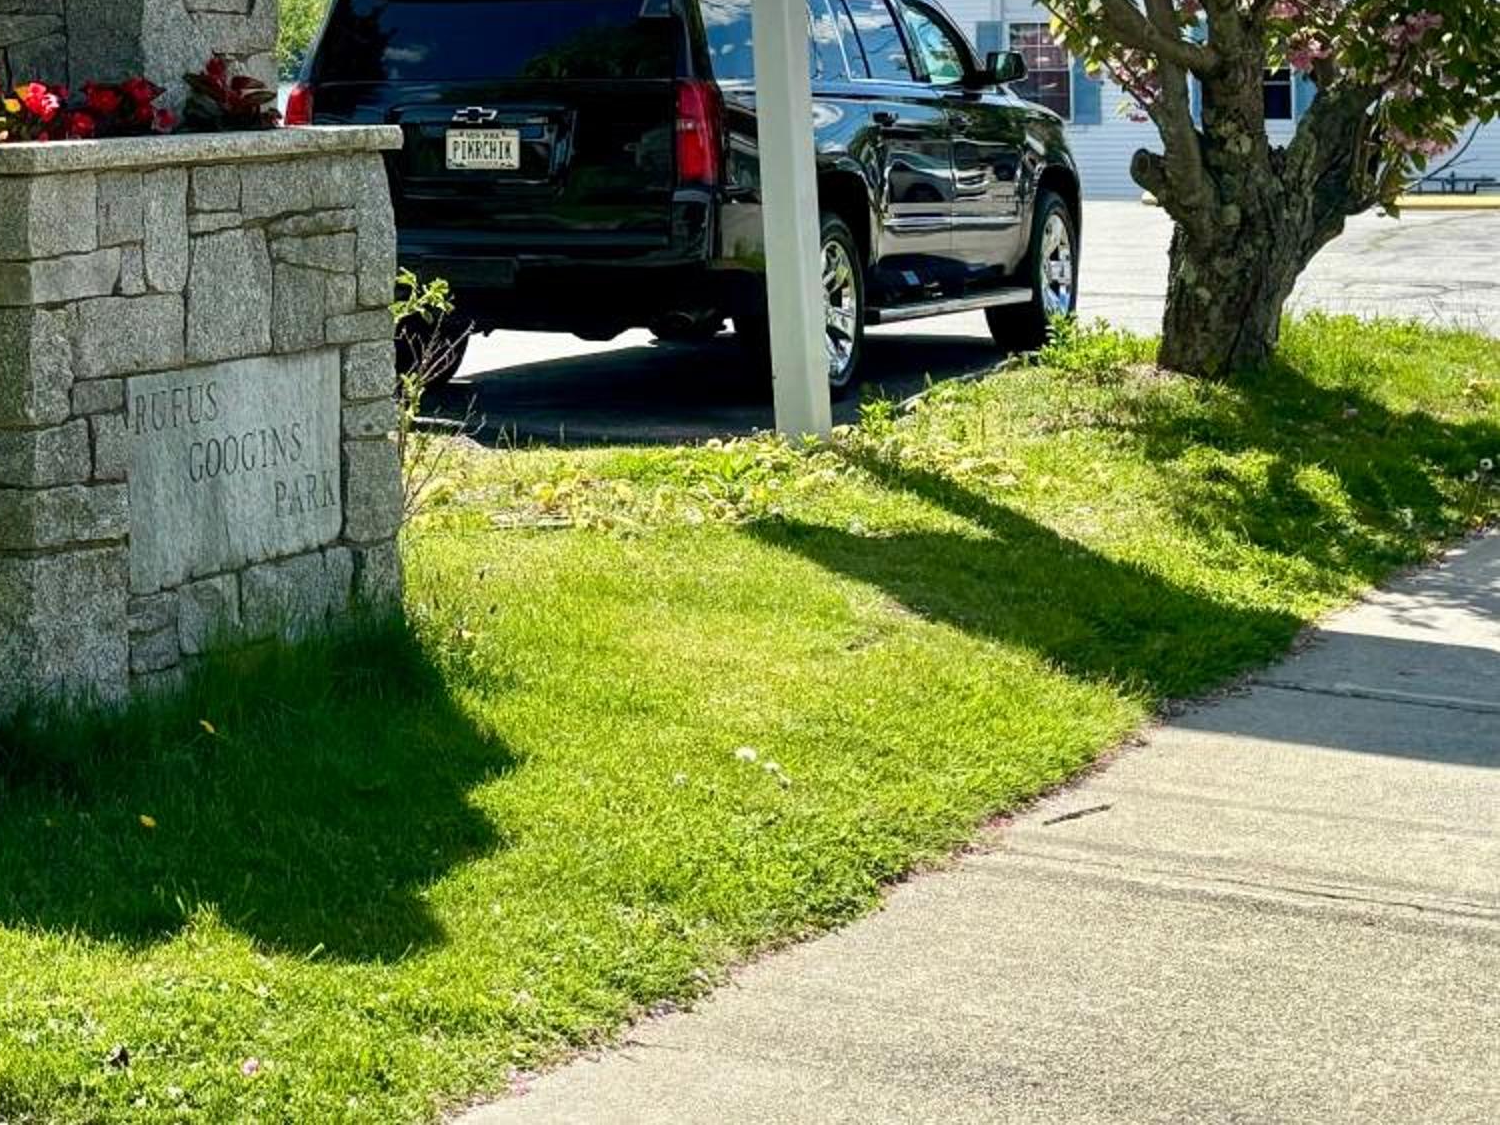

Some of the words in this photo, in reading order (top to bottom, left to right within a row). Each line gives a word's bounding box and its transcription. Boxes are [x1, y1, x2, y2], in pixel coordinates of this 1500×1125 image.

[135, 381, 220, 435] RUFUS
[189, 422, 302, 483] GOOGINS
[274, 470, 336, 518] PARK
